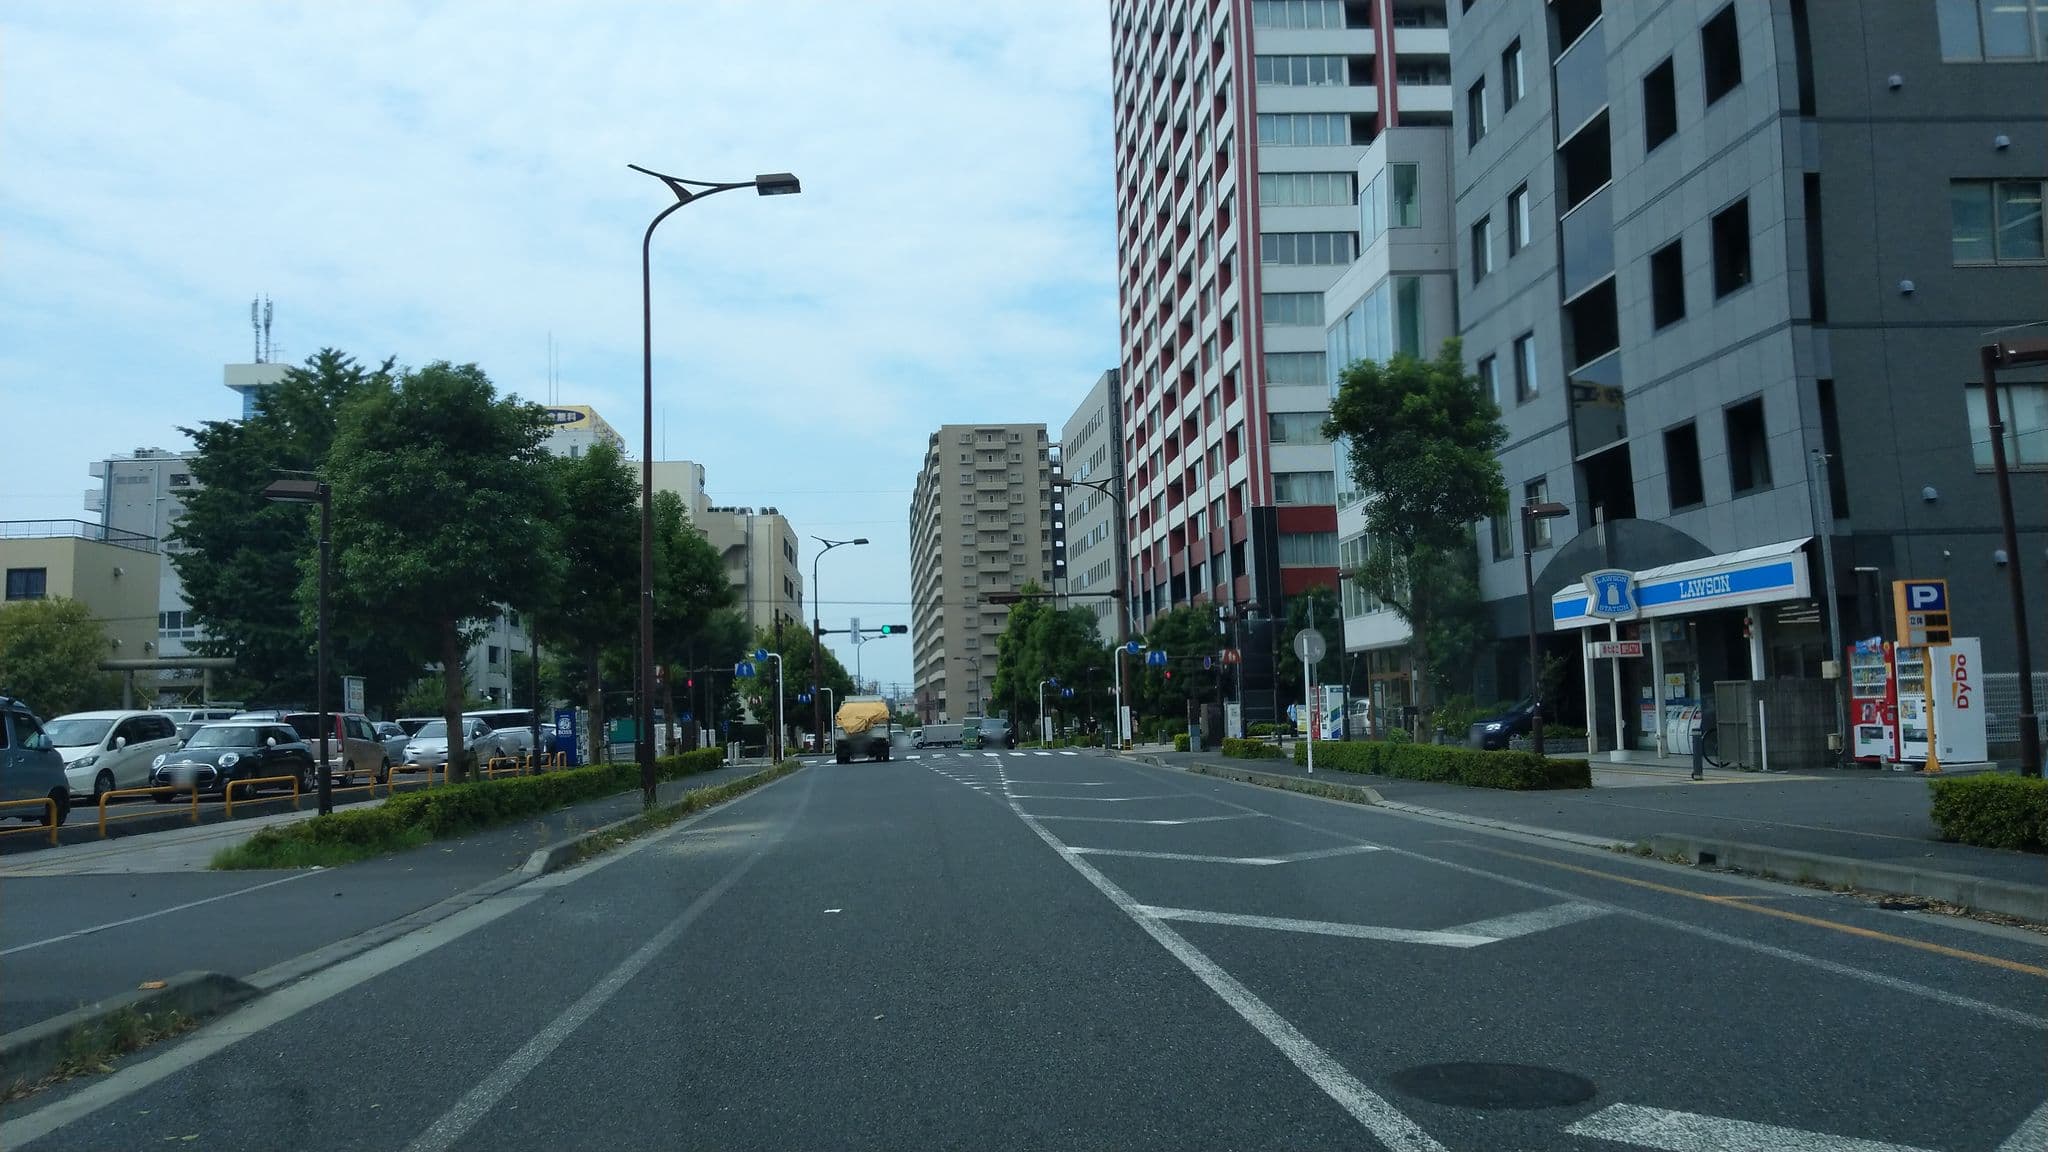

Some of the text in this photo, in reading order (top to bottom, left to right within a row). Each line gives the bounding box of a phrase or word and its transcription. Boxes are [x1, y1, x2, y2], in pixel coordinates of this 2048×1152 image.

[1596, 576, 1628, 584] LAWSON
[1680, 575, 1731, 598] LAWSON
[1599, 604, 1629, 612] STATION
[1912, 586, 1938, 608] P
[1956, 654, 1972, 709] DyDo
